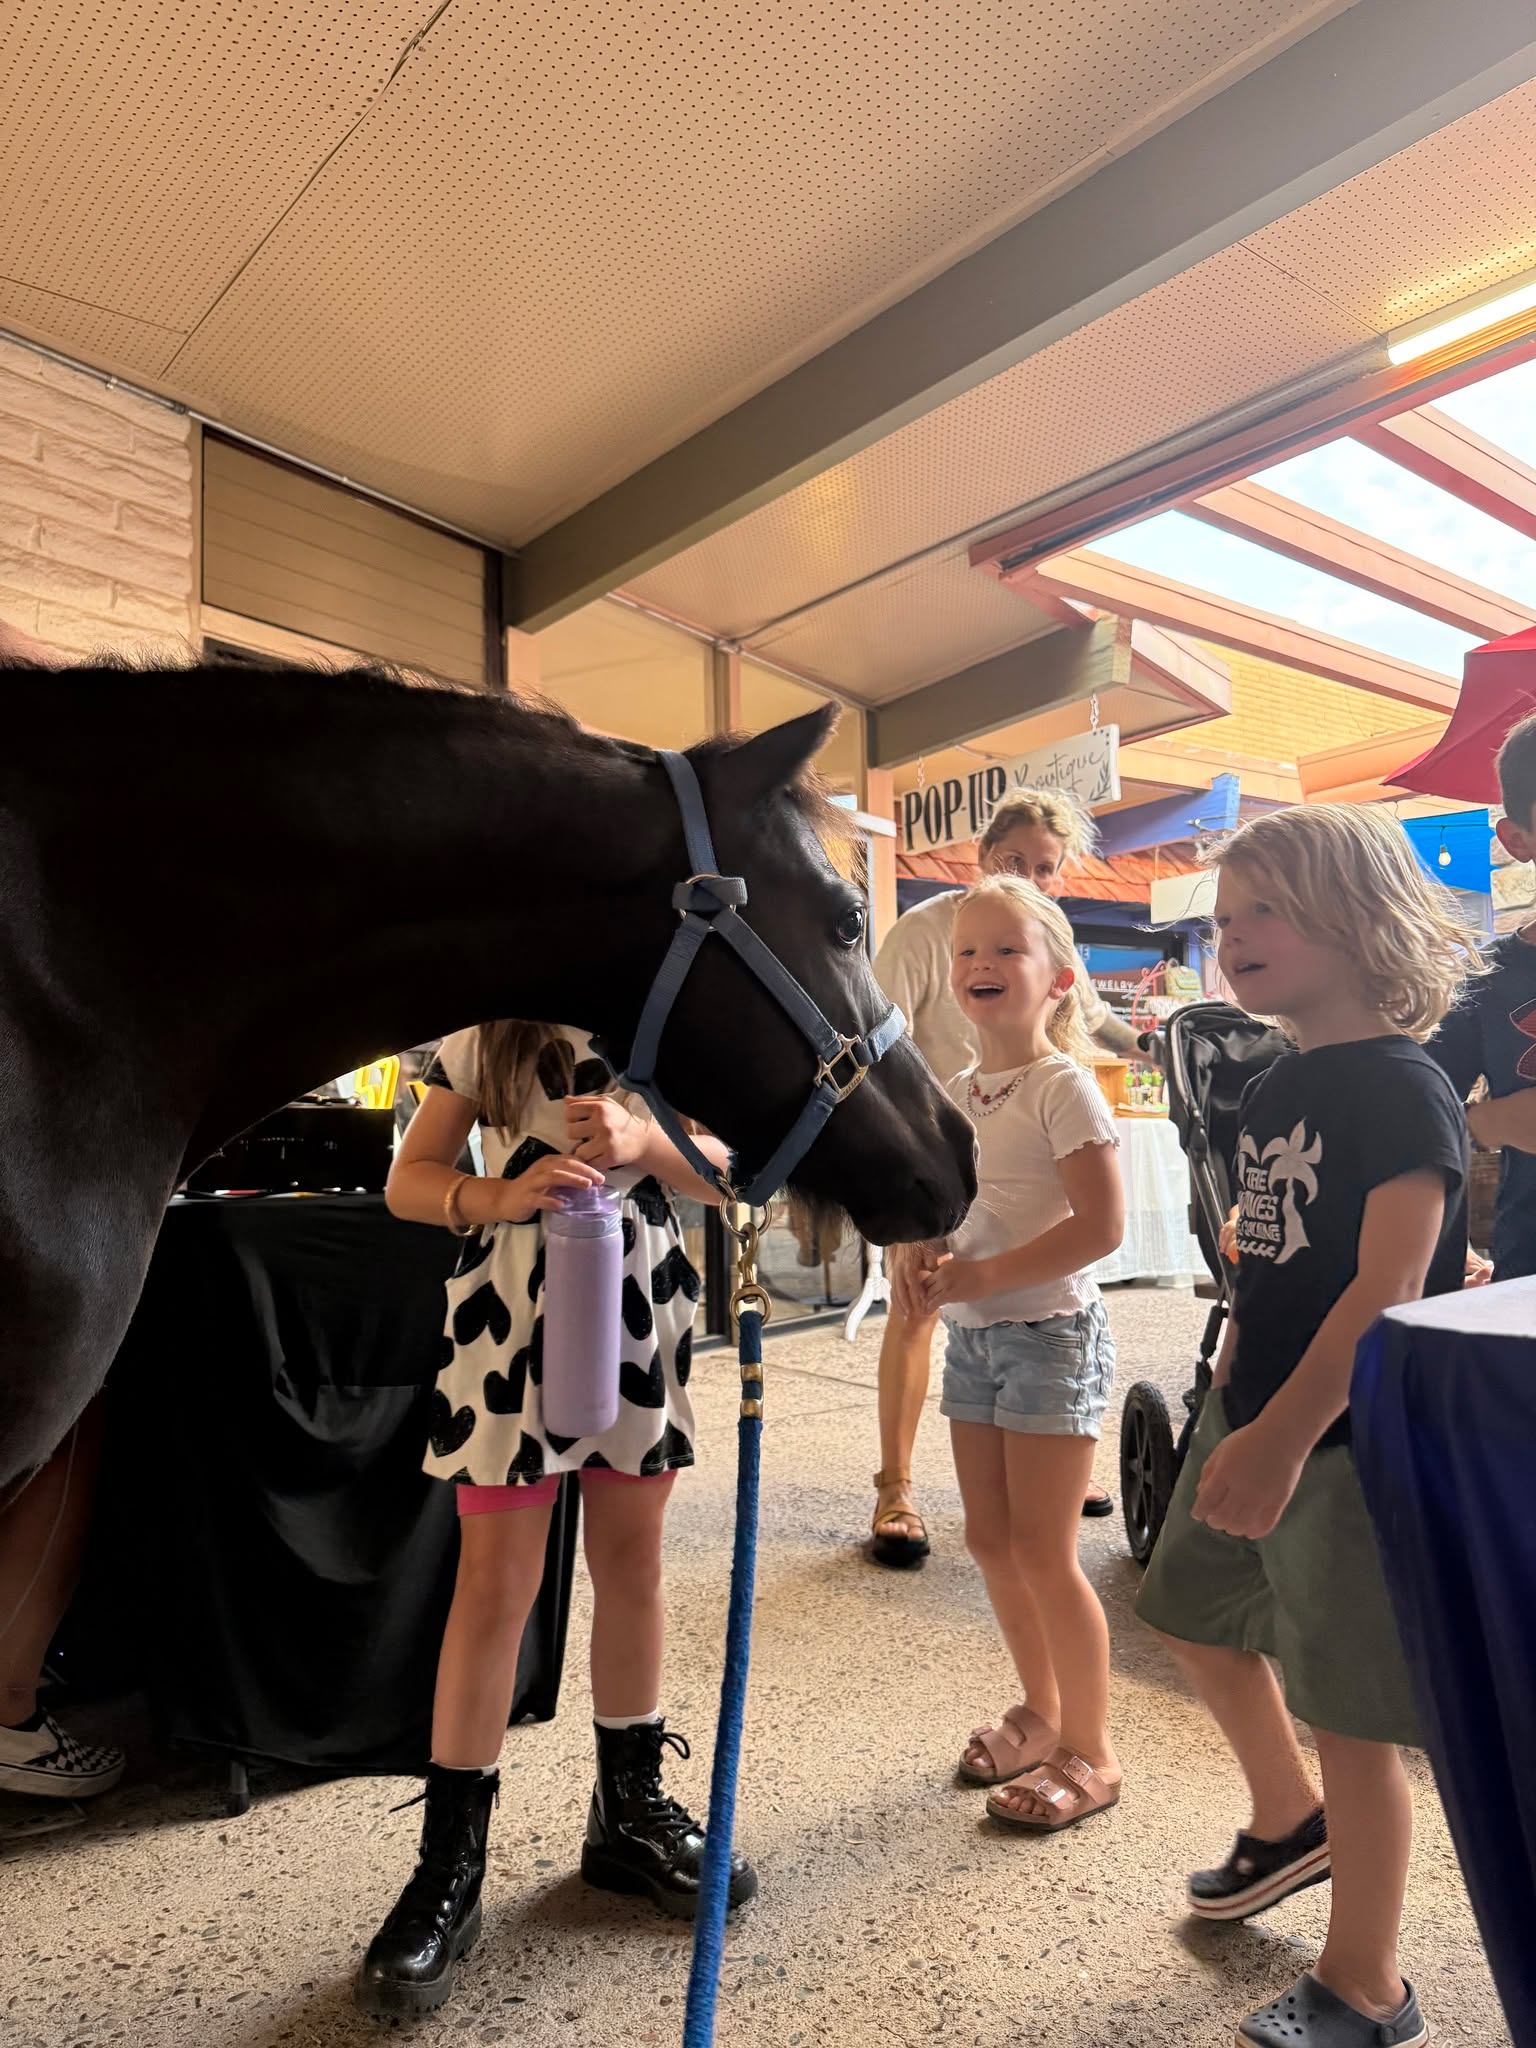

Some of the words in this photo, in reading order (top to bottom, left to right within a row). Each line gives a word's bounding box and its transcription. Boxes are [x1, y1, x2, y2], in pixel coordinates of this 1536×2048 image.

[903, 765, 1007, 851] POP-UP
[1090, 979, 1135, 989] EWELRY
[1245, 1166, 1268, 1192] THE
